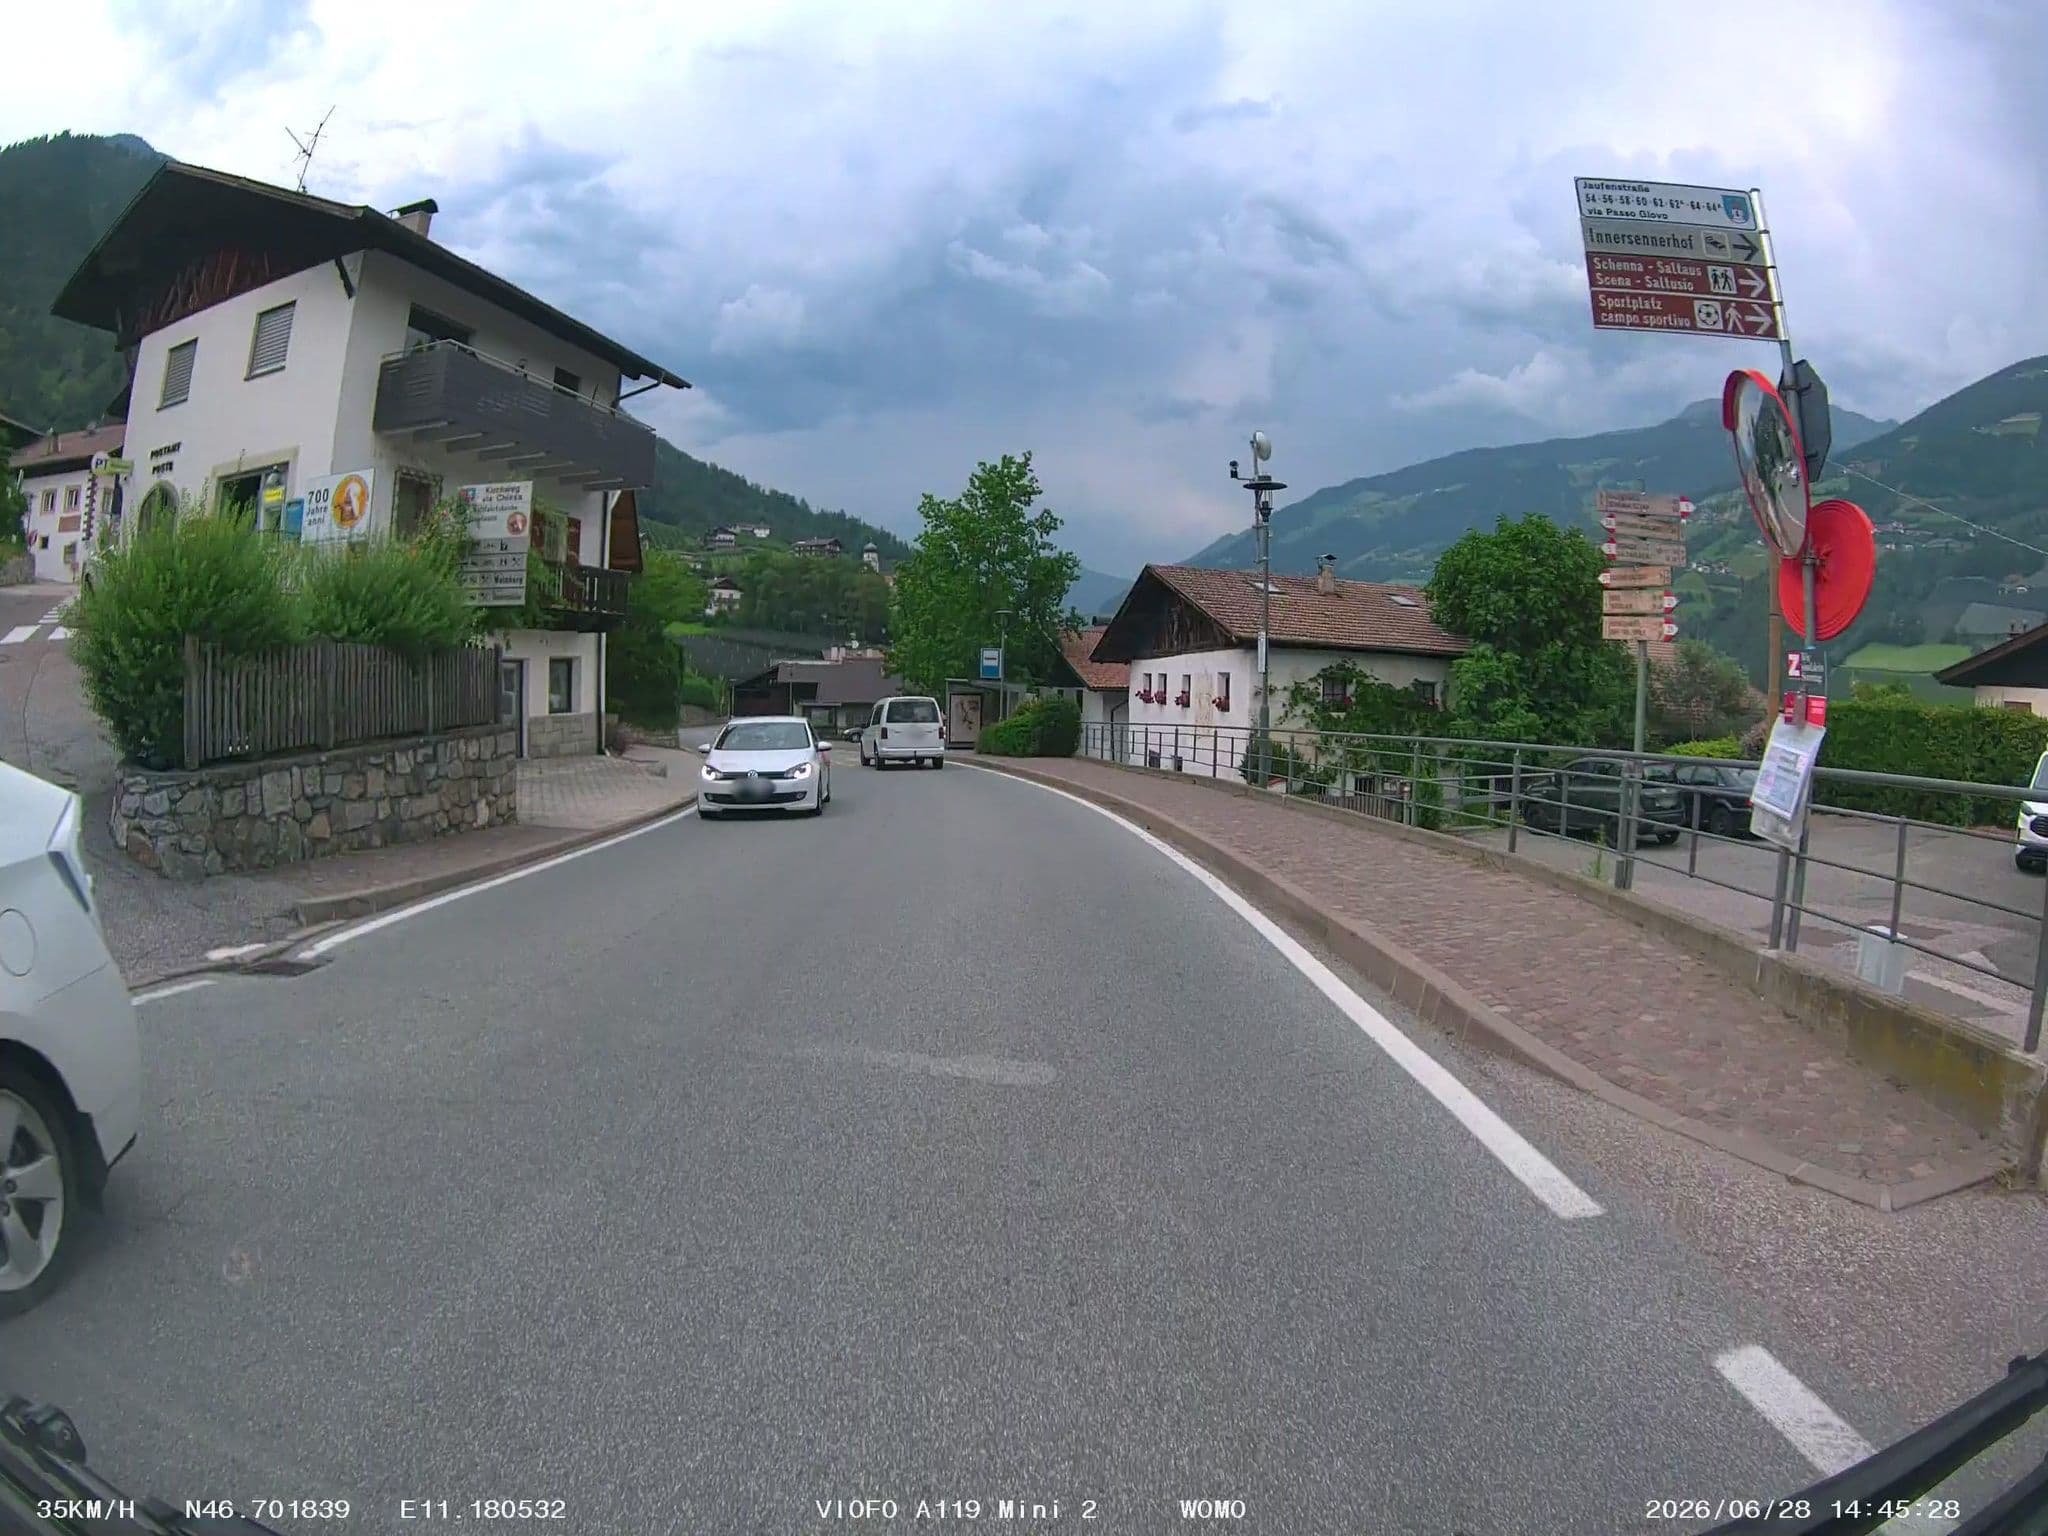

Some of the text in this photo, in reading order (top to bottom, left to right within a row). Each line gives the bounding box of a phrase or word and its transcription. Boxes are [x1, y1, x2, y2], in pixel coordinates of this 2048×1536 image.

[1587, 208, 1602, 216] via
[1606, 208, 1636, 218] Passo
[1589, 228, 1694, 250] Innersennerhof
[1593, 257, 1644, 272] Schenna
[1657, 261, 1702, 276] Saltaus
[1596, 273, 1632, 286] Scena
[1645, 275, 1694, 291] Saltusio
[1599, 294, 1663, 310] Sportplatz
[1601, 312, 1691, 328] campo sportivo
[308, 488, 329, 504] 700
[306, 505, 328, 516] Jahre
